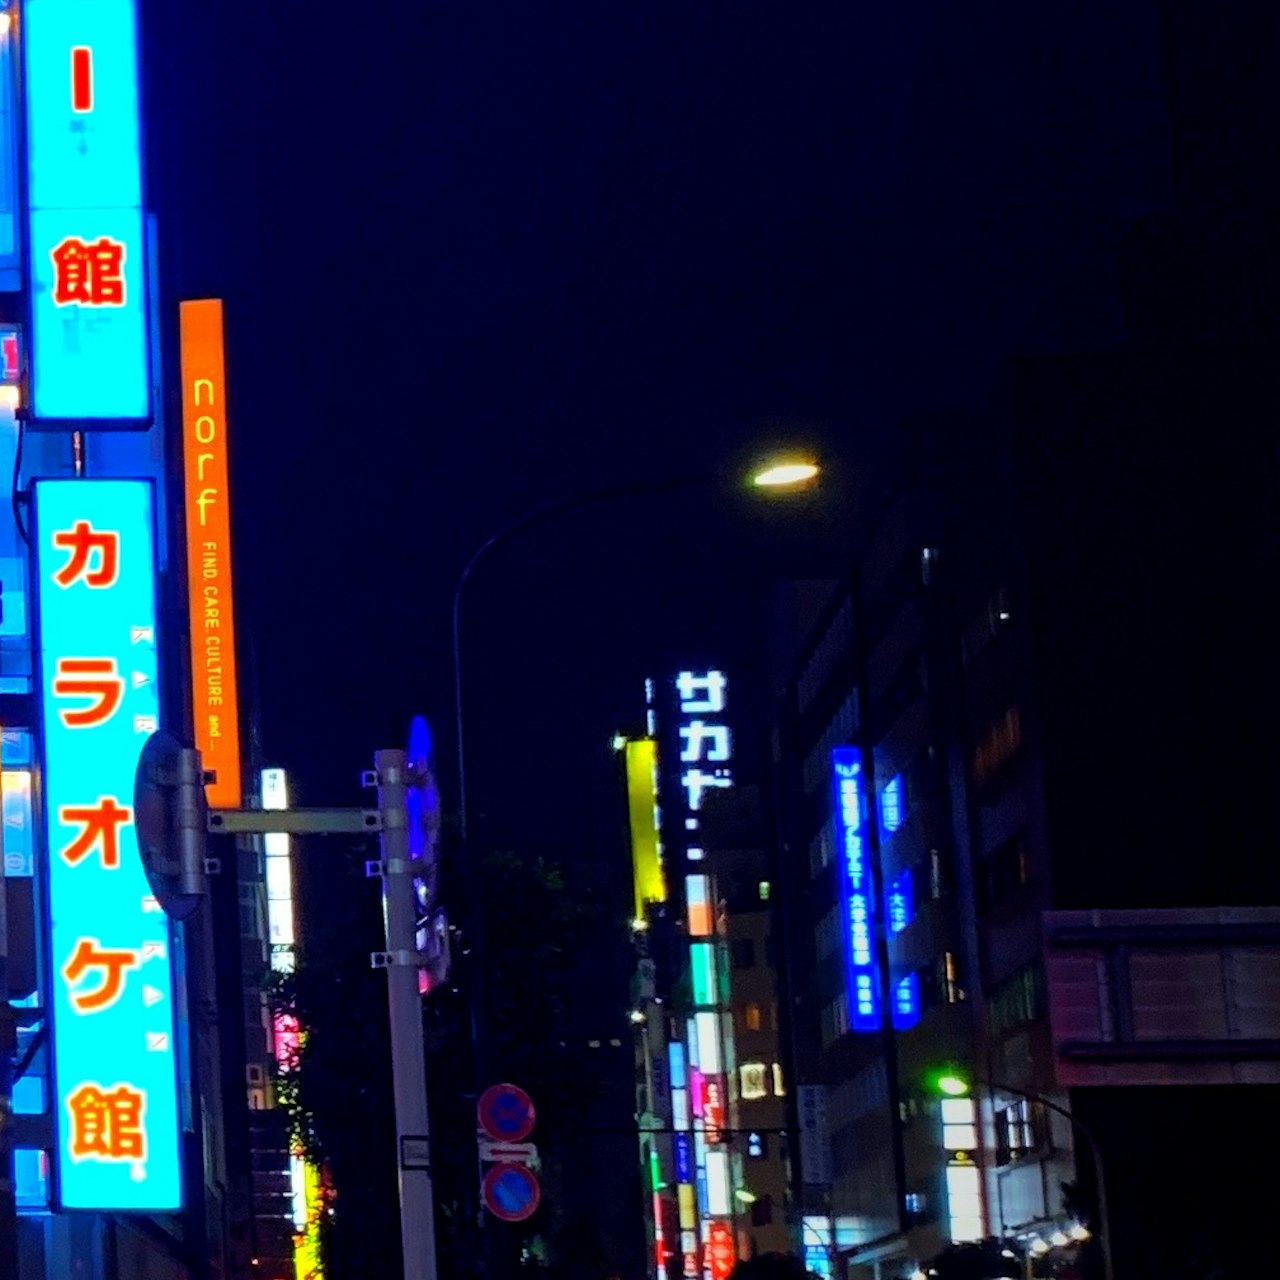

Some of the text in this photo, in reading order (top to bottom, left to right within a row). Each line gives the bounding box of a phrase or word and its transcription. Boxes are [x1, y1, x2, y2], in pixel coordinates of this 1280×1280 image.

[194, 379, 218, 526] norf
[205, 635, 222, 706] CULTURE
[53, 522, 148, 1163] カラオケ館
